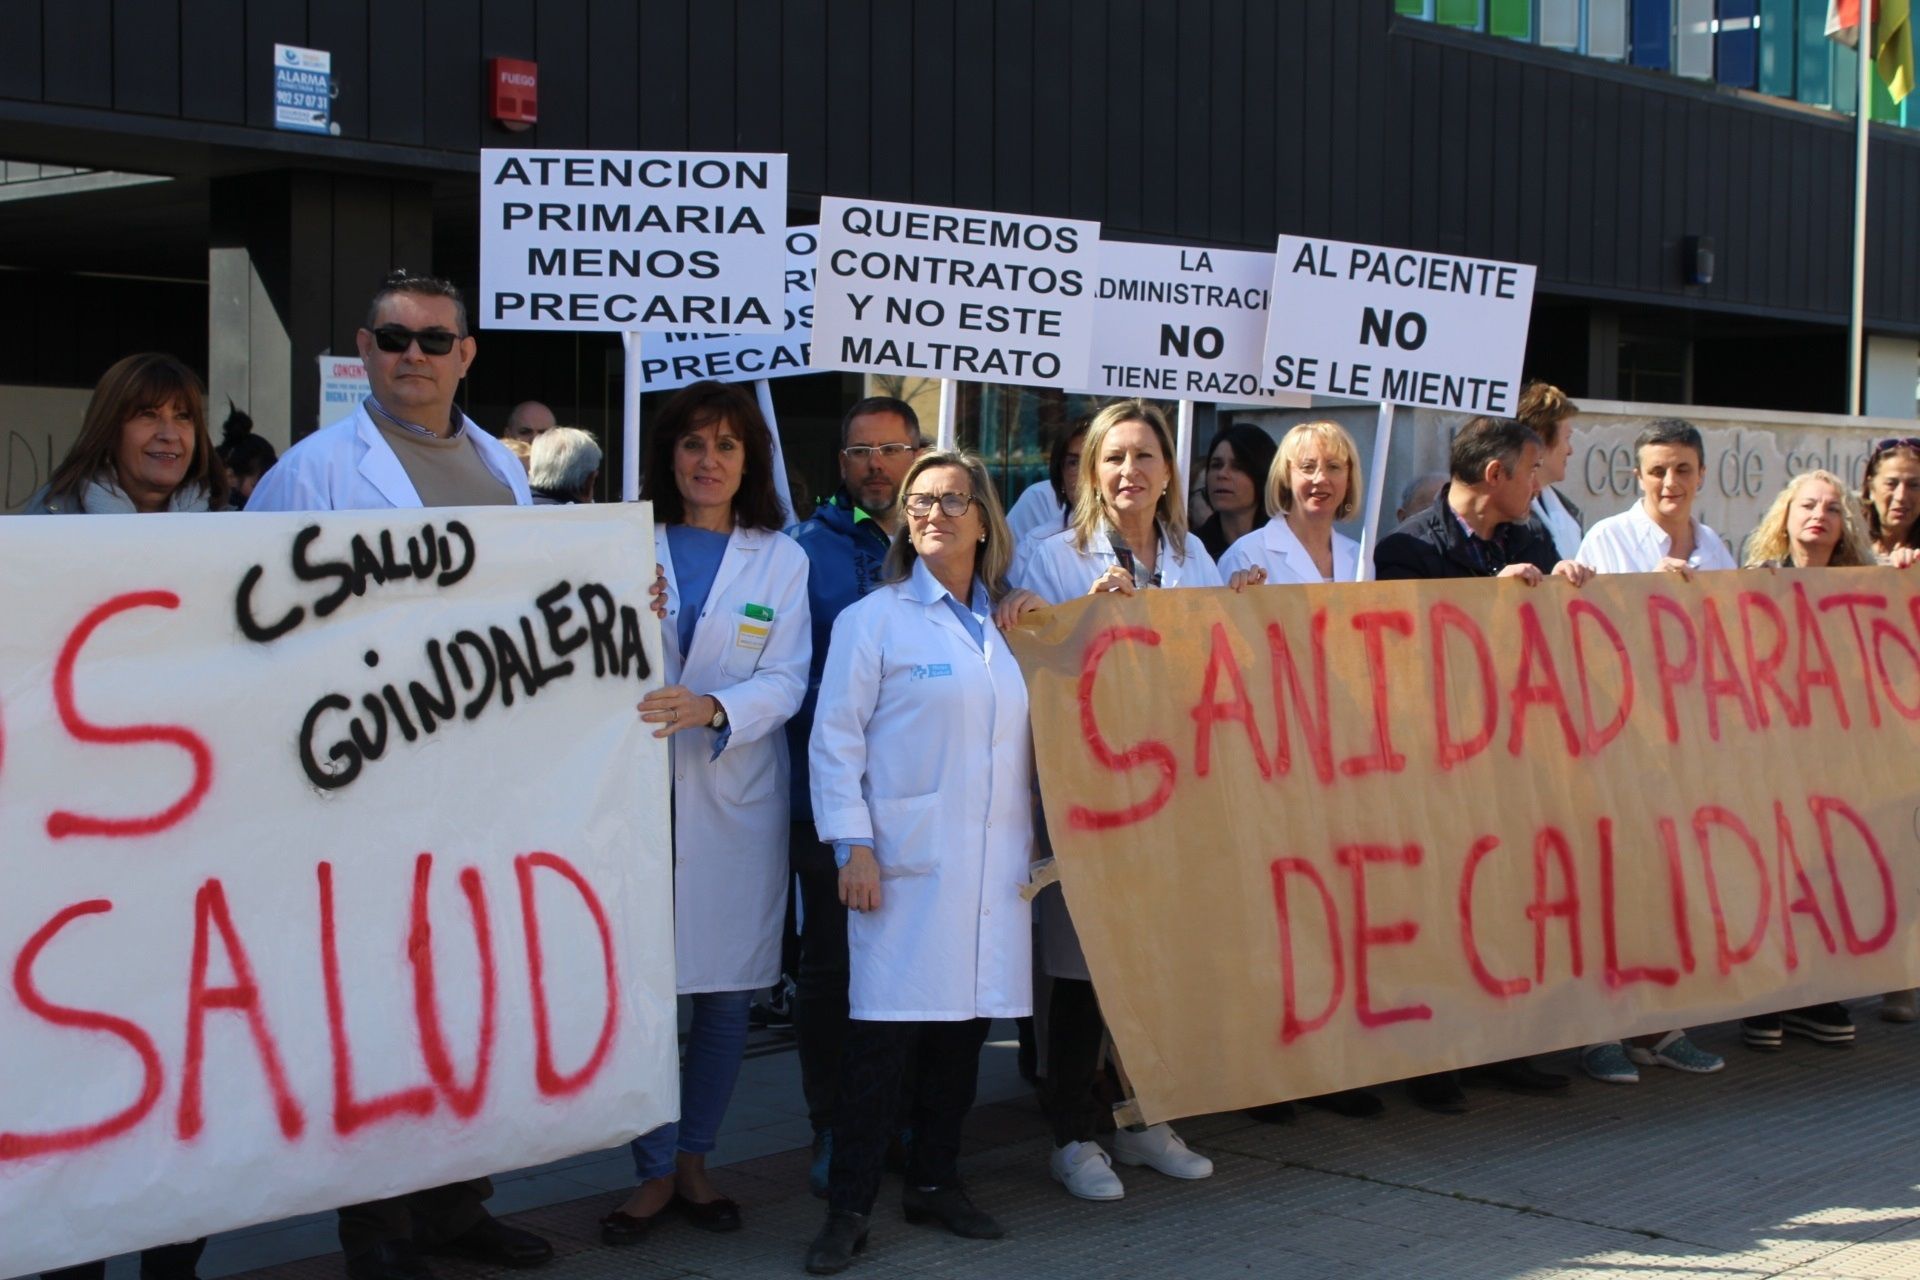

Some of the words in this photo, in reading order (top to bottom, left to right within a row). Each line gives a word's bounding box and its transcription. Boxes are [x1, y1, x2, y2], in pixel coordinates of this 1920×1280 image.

[277, 69, 327, 88] ALARMA
[501, 72, 535, 88] FUEGO
[495, 157, 768, 189] ATENCION
[502, 202, 766, 235] PRIMARIA
[842, 206, 1079, 254] QUEREMOS
[527, 247, 720, 279] MENOS
[830, 249, 1084, 297] CONTRATOS
[1180, 250, 1213, 273] LA
[1292, 242, 1338, 278] AL
[1349, 248, 1518, 300] PACIENTE
[494, 292, 772, 325] PRECARIA
[846, 293, 874, 321] Y
[886, 296, 945, 327] NO
[959, 303, 1062, 337] ESTE
[1094, 277, 1272, 311] DMINISTRACI
[1159, 323, 1225, 360] NO
[1359, 306, 1427, 351] NO
[841, 336, 1061, 379] MALTRATO
[1101, 364, 1178, 391] TIENE
[1273, 355, 1319, 390] SE
[1328, 361, 1372, 397] LE
[1380, 367, 1509, 414] MIENTE
[1719, 432, 1764, 498] de
[1066, 597, 1637, 837] SANIDAD
[1814, 590, 1920, 731] TO
[1269, 840, 1434, 1047] DE
[1457, 793, 1899, 999] CALIDAD
[0, 850, 621, 1163] SALUD
